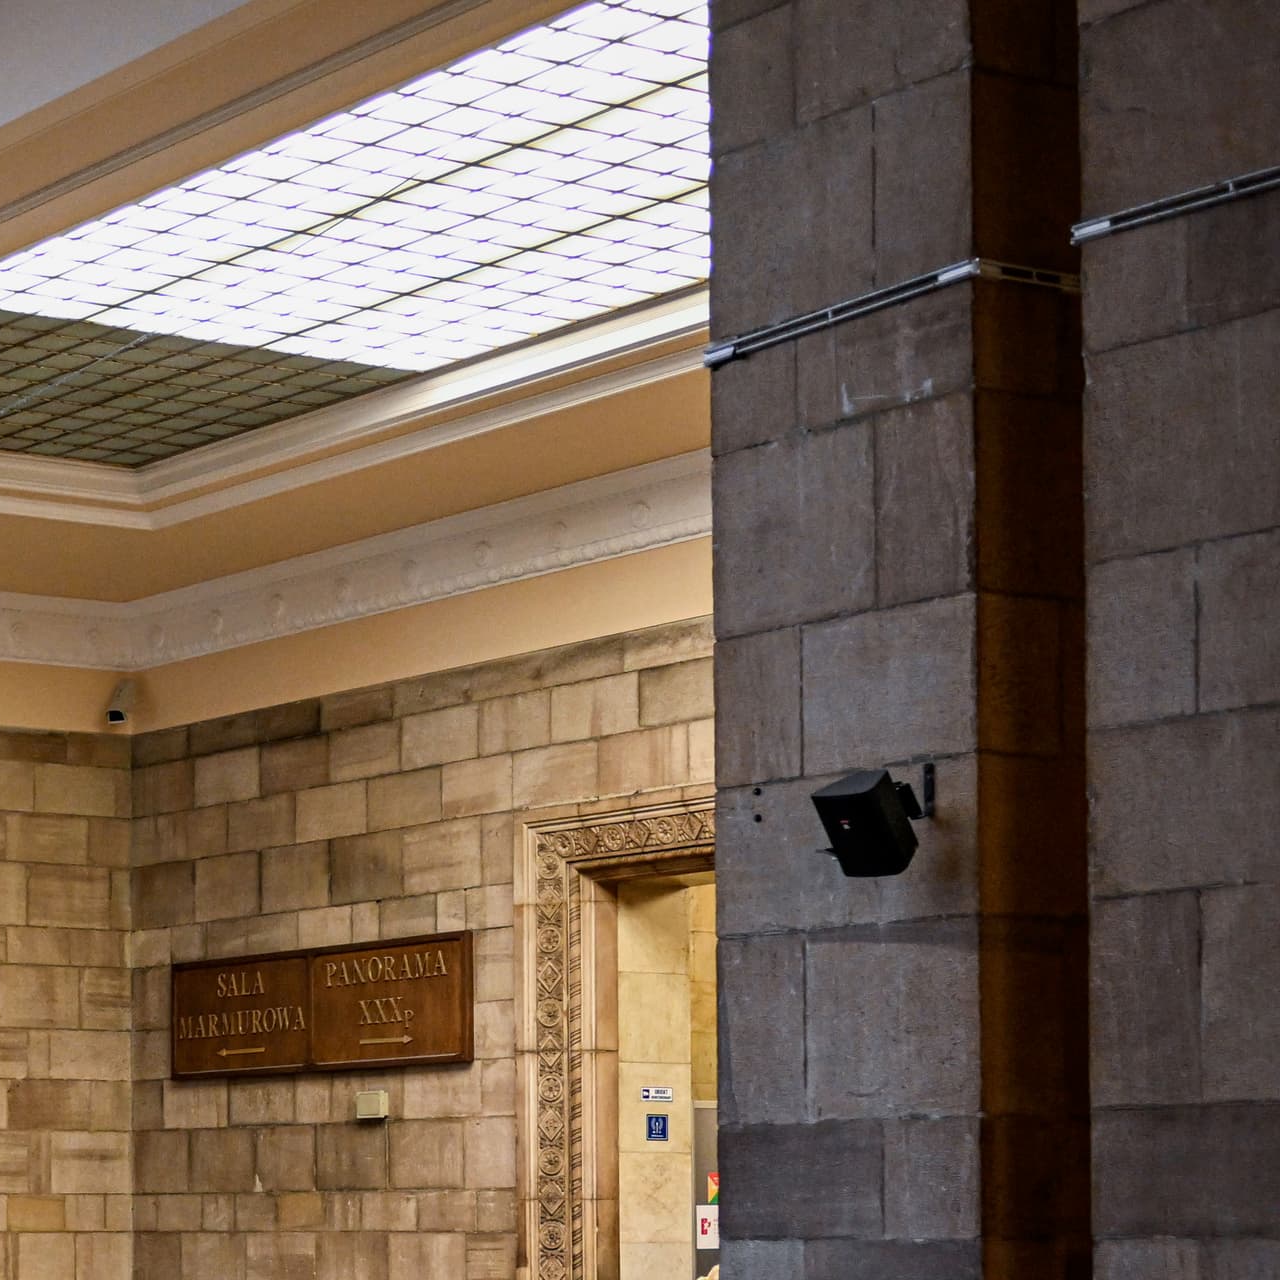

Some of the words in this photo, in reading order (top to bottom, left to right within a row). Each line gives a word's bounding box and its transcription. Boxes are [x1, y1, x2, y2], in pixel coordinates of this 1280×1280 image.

[217, 970, 264, 998] SALA
[326, 950, 448, 988] PANORAMA
[178, 1006, 307, 1039] MARMUROWA
